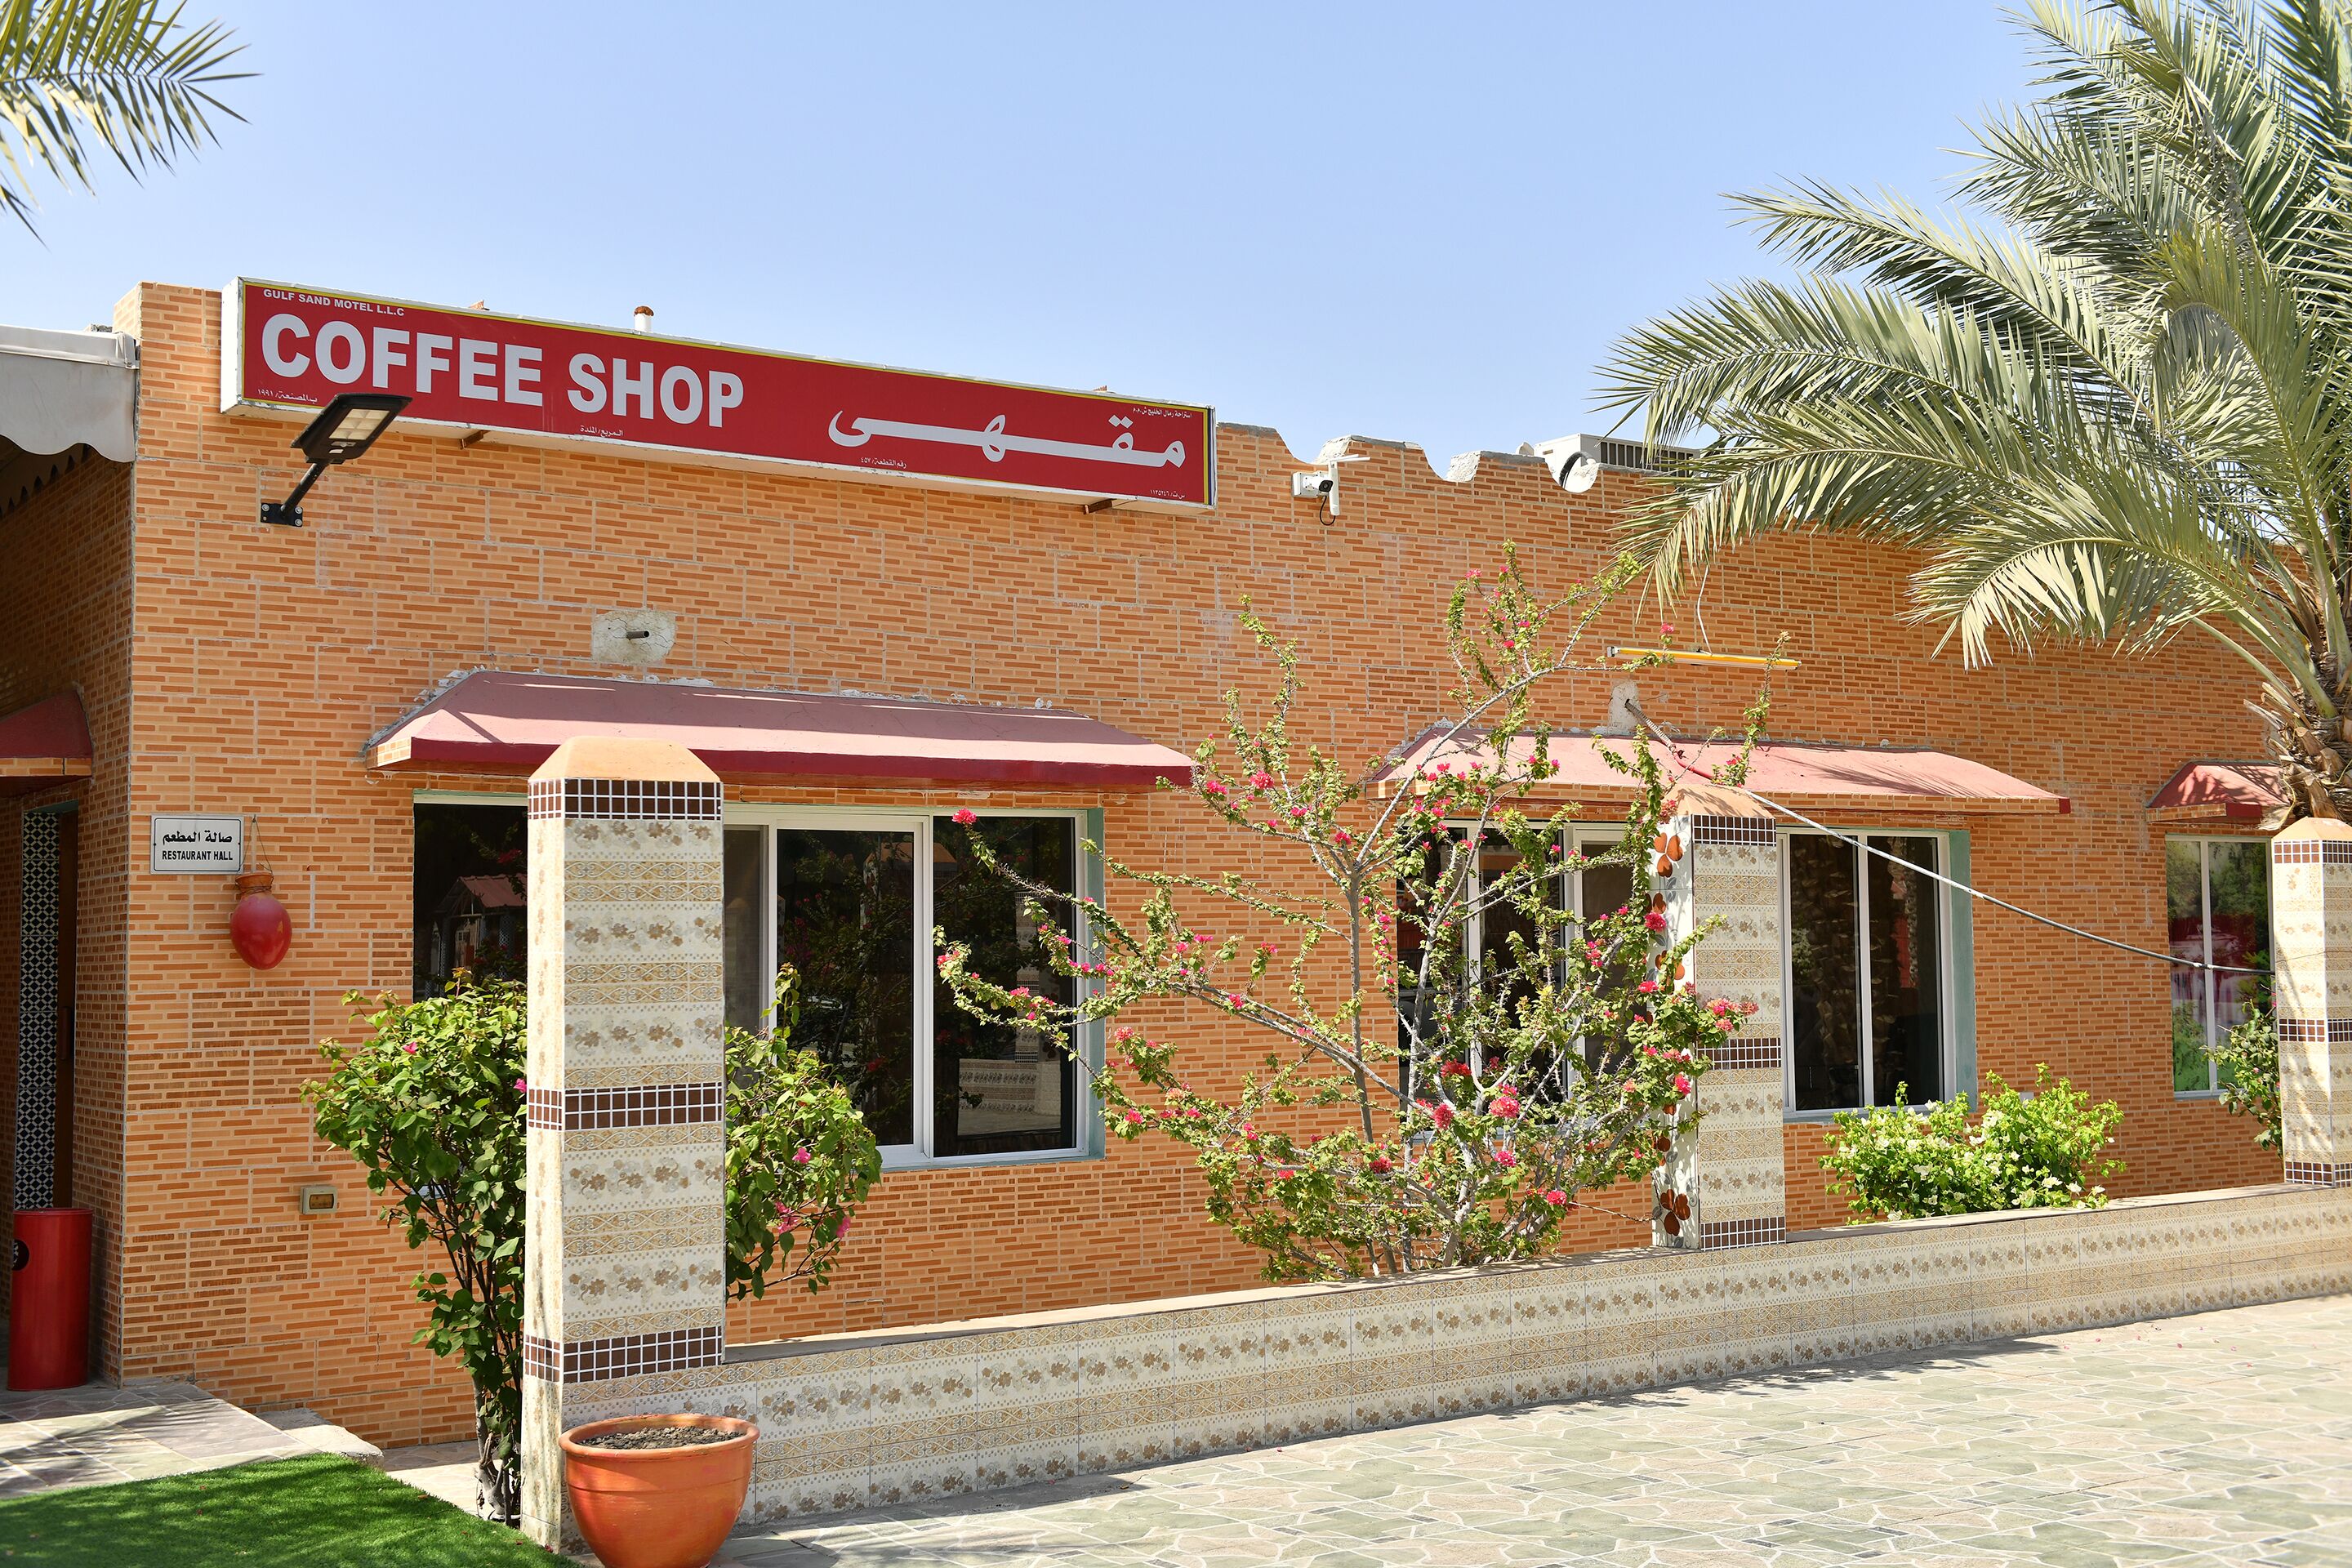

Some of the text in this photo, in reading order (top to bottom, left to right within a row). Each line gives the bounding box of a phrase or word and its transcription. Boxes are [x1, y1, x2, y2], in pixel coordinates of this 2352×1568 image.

[263, 288, 405, 316] GULF SAND MOTEL L.L.C
[261, 314, 744, 429] COFFEE SHOP
[1147, 408, 1163, 416] الخليج
[1163, 410, 1174, 418] رمال
[828, 410, 1187, 469] مقهى
[163, 830, 233, 845] صالة المطعم
[162, 850, 234, 861] RESTAURANT HALL
